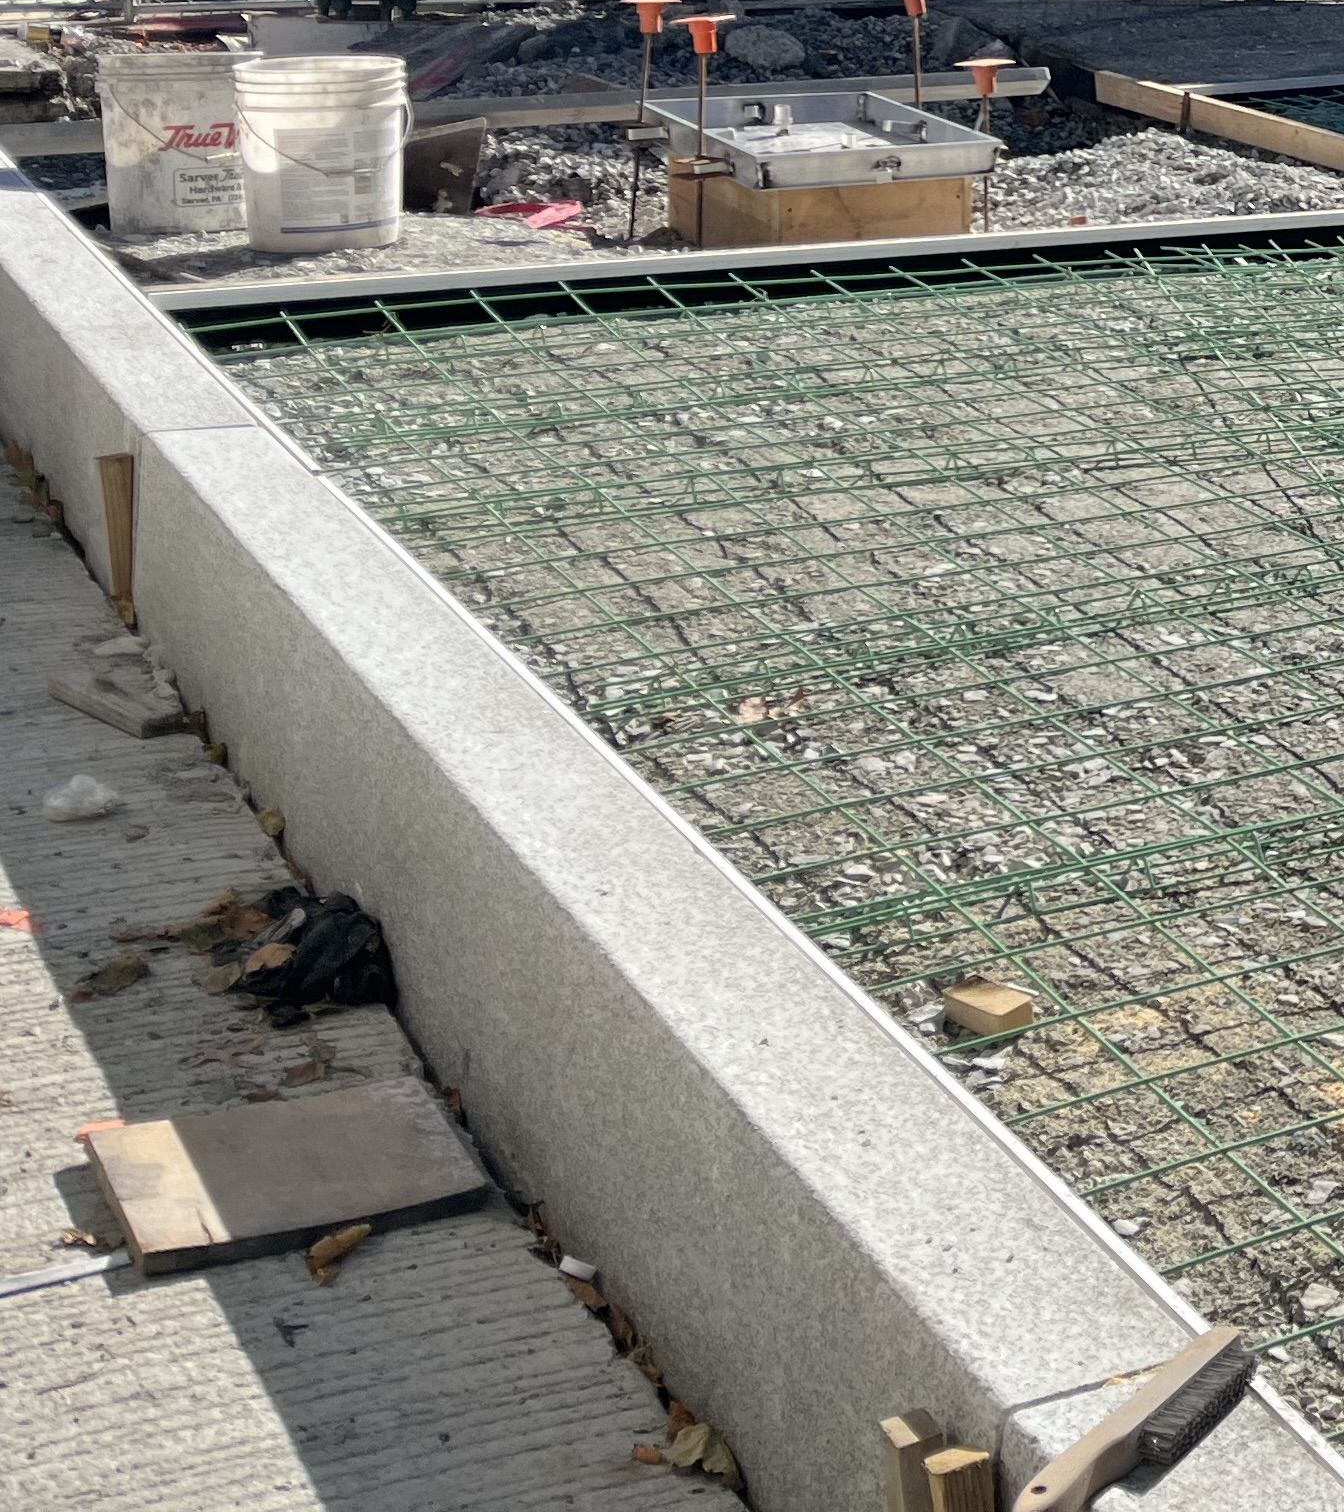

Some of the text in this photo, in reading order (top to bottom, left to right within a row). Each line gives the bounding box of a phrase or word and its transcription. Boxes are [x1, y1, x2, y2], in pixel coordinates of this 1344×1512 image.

[158, 124, 222, 152] True
[179, 173, 219, 184] Sarver
[190, 184, 235, 194] Hardware
